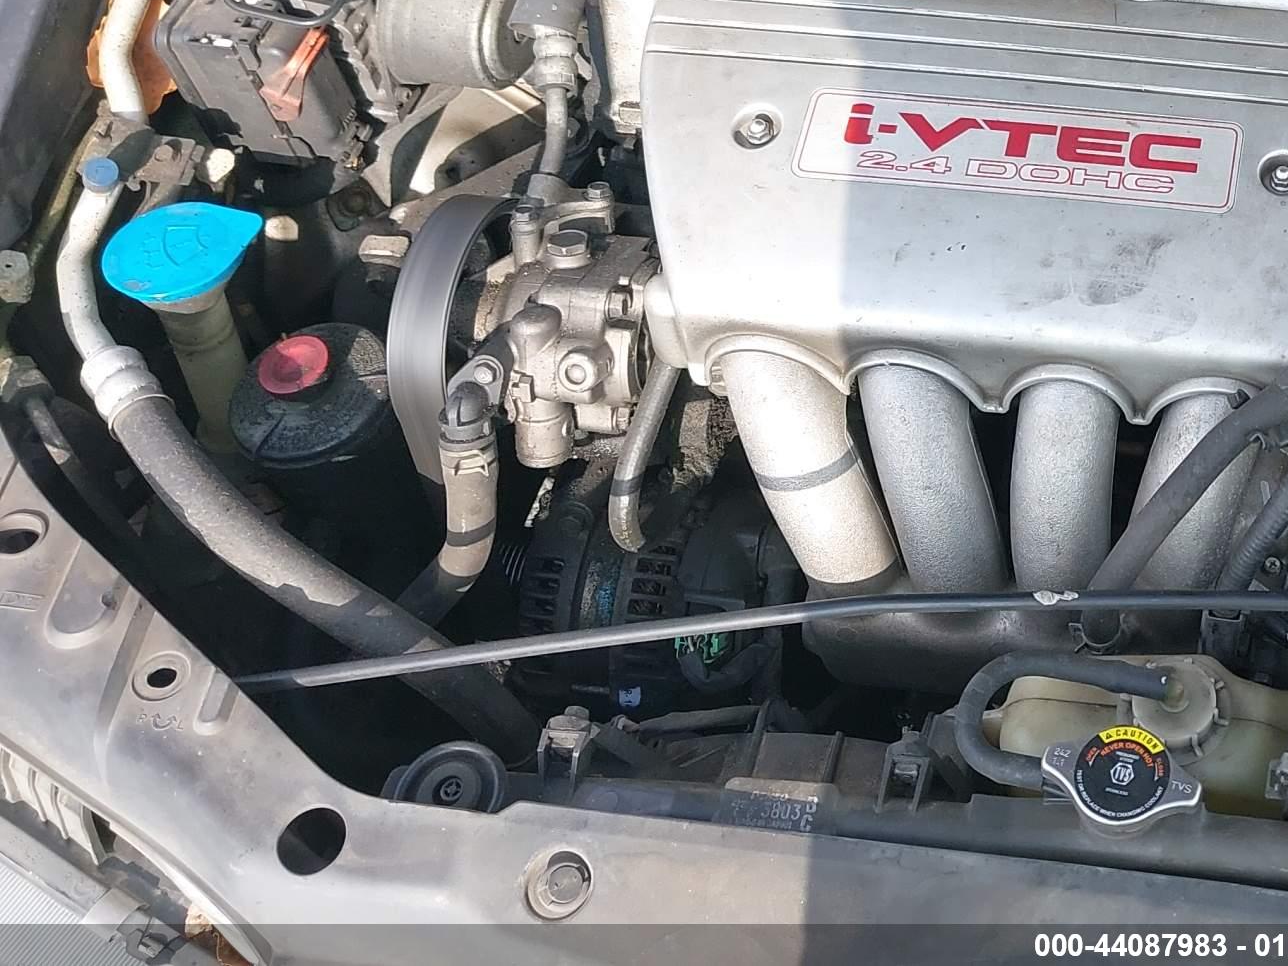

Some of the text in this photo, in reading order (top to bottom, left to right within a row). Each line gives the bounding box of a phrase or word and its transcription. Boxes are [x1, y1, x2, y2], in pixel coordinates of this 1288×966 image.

[843, 103, 1202, 174] i-VTEC
[856, 150, 1176, 194] 2.4 DOHC
[1115, 728, 1161, 750] CAUTION
[1100, 741, 1125, 756] NEVER
[1125, 742, 1144, 756] OPEN
[1143, 752, 1154, 768] HOT
[1115, 766, 1131, 782] TVS
[1170, 780, 1193, 794] TVS
[1081, 791, 1100, 811] REPLACE
[1099, 808, 1117, 817] WHEN
[1116, 807, 1145, 818] CHANGING
[1144, 786, 1165, 809] COOLANT
